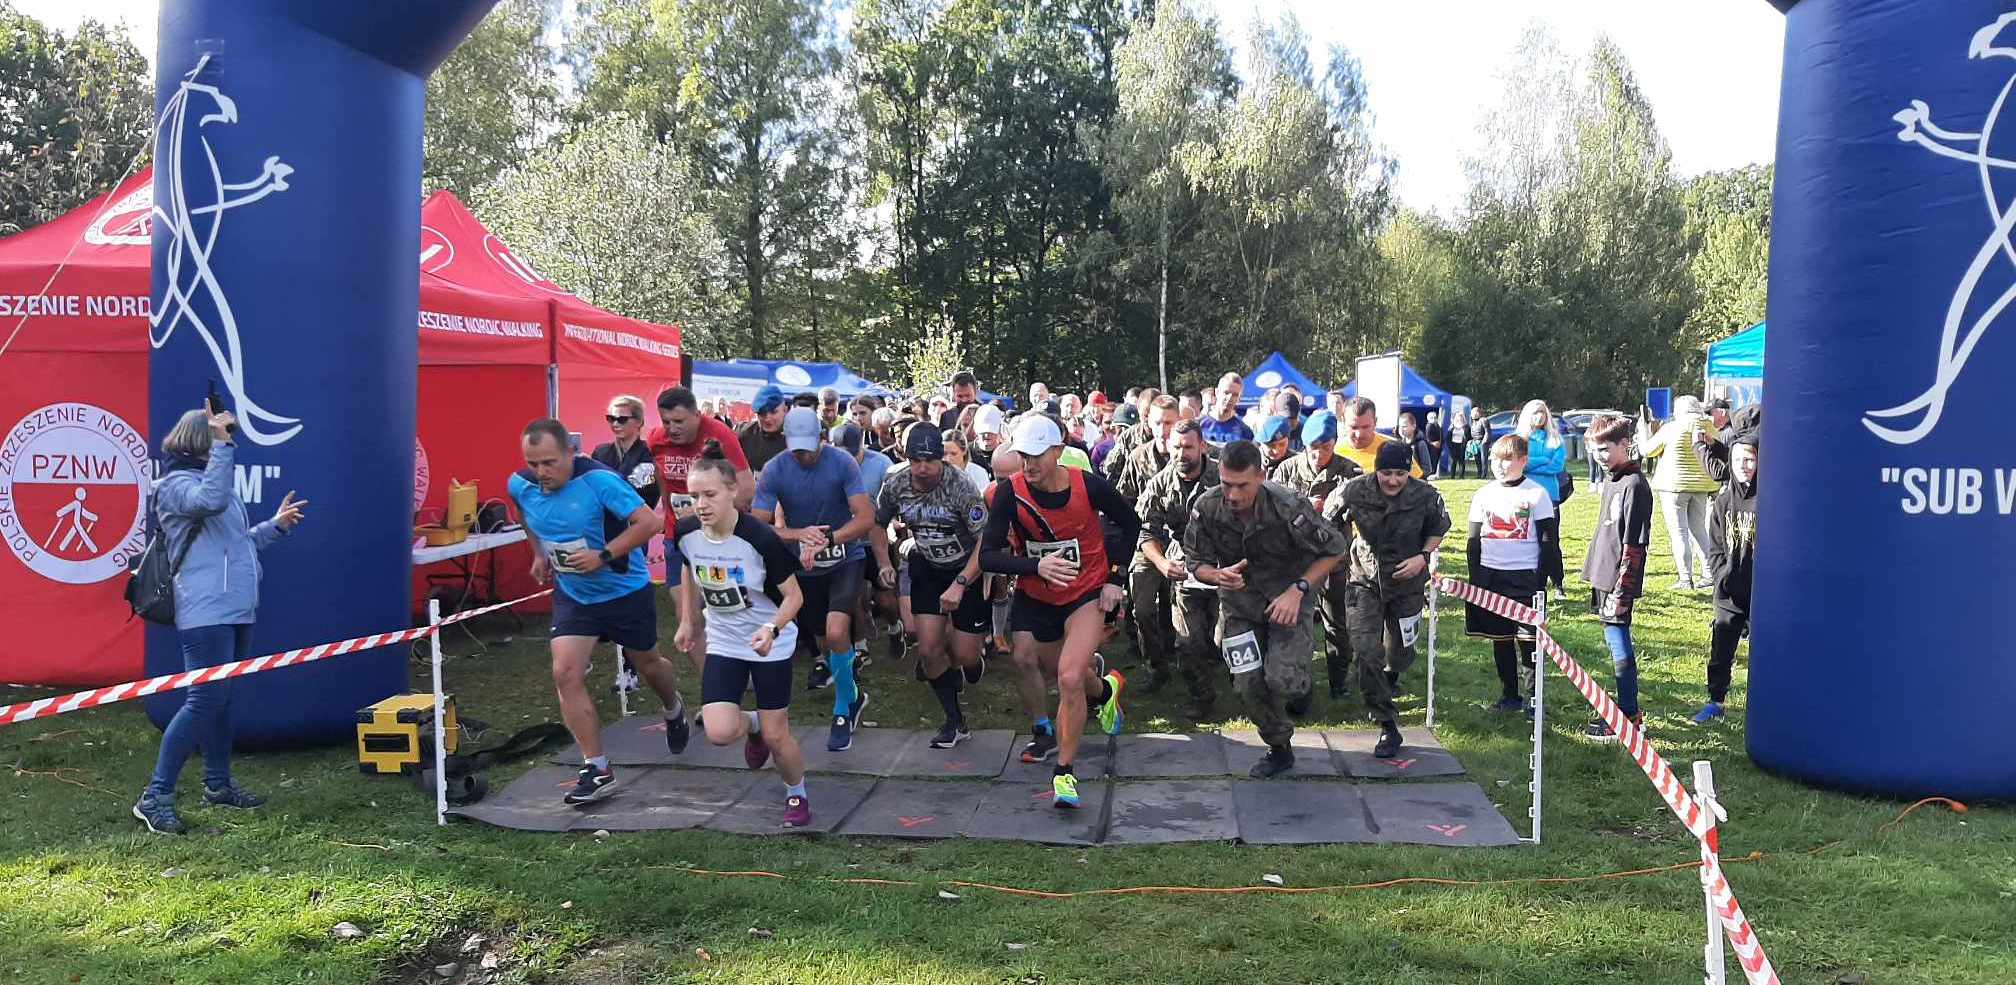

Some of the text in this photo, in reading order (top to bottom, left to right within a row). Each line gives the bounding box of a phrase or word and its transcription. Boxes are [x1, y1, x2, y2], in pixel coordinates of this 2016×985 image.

[465, 317, 504, 336] NORDIC
[502, 319, 543, 338] WALKING
[0, 407, 87, 476] ZRZESZENIE
[98, 414, 149, 477] NORDIC
[32, 454, 117, 480] PZNW
[1881, 467, 1983, 514] "SUB
[0, 486, 37, 562] POLSKIE
[935, 545, 957, 558] 36
[711, 592, 731, 605] 41
[1231, 646, 1255, 666] 84
